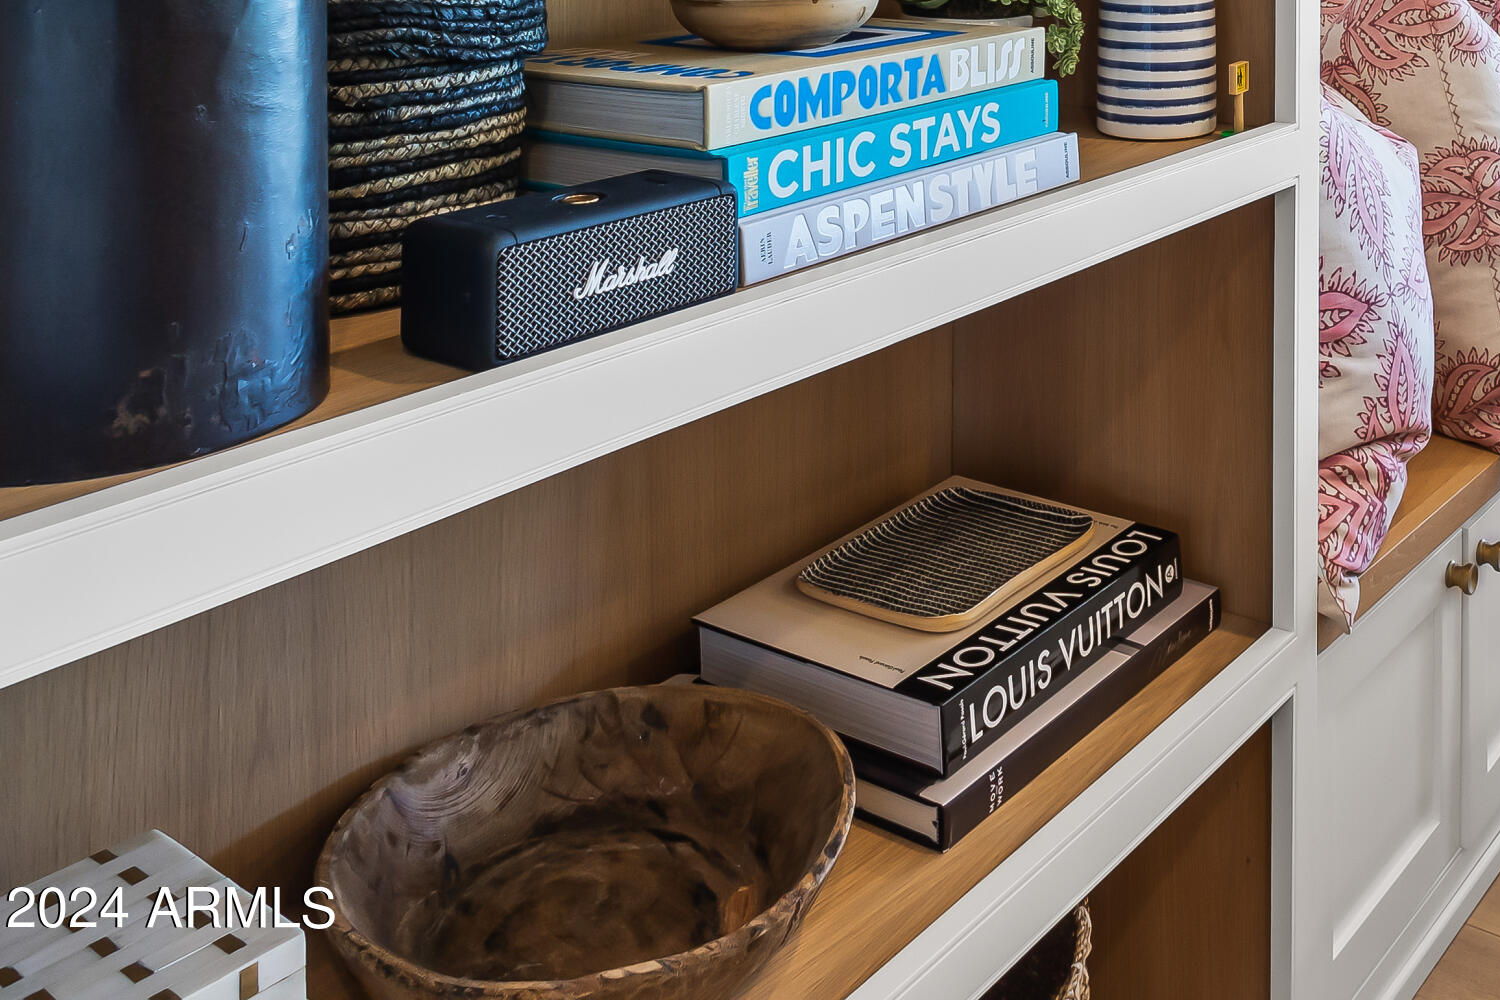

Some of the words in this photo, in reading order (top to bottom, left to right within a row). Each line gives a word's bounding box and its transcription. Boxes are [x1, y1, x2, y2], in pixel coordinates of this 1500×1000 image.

[750, 54, 947, 130] COMPORTA
[950, 37, 1026, 92] BLISS
[743, 156, 759, 214] Traveller
[767, 131, 876, 199] CHIC
[889, 102, 1001, 168] STAYS
[573, 247, 678, 300] Marshall
[1066, 529, 1162, 587] LOUIS
[917, 591, 1083, 690] VUITTON
[969, 649, 1051, 744] LOUIS
[1058, 564, 1164, 671] VUITTON
